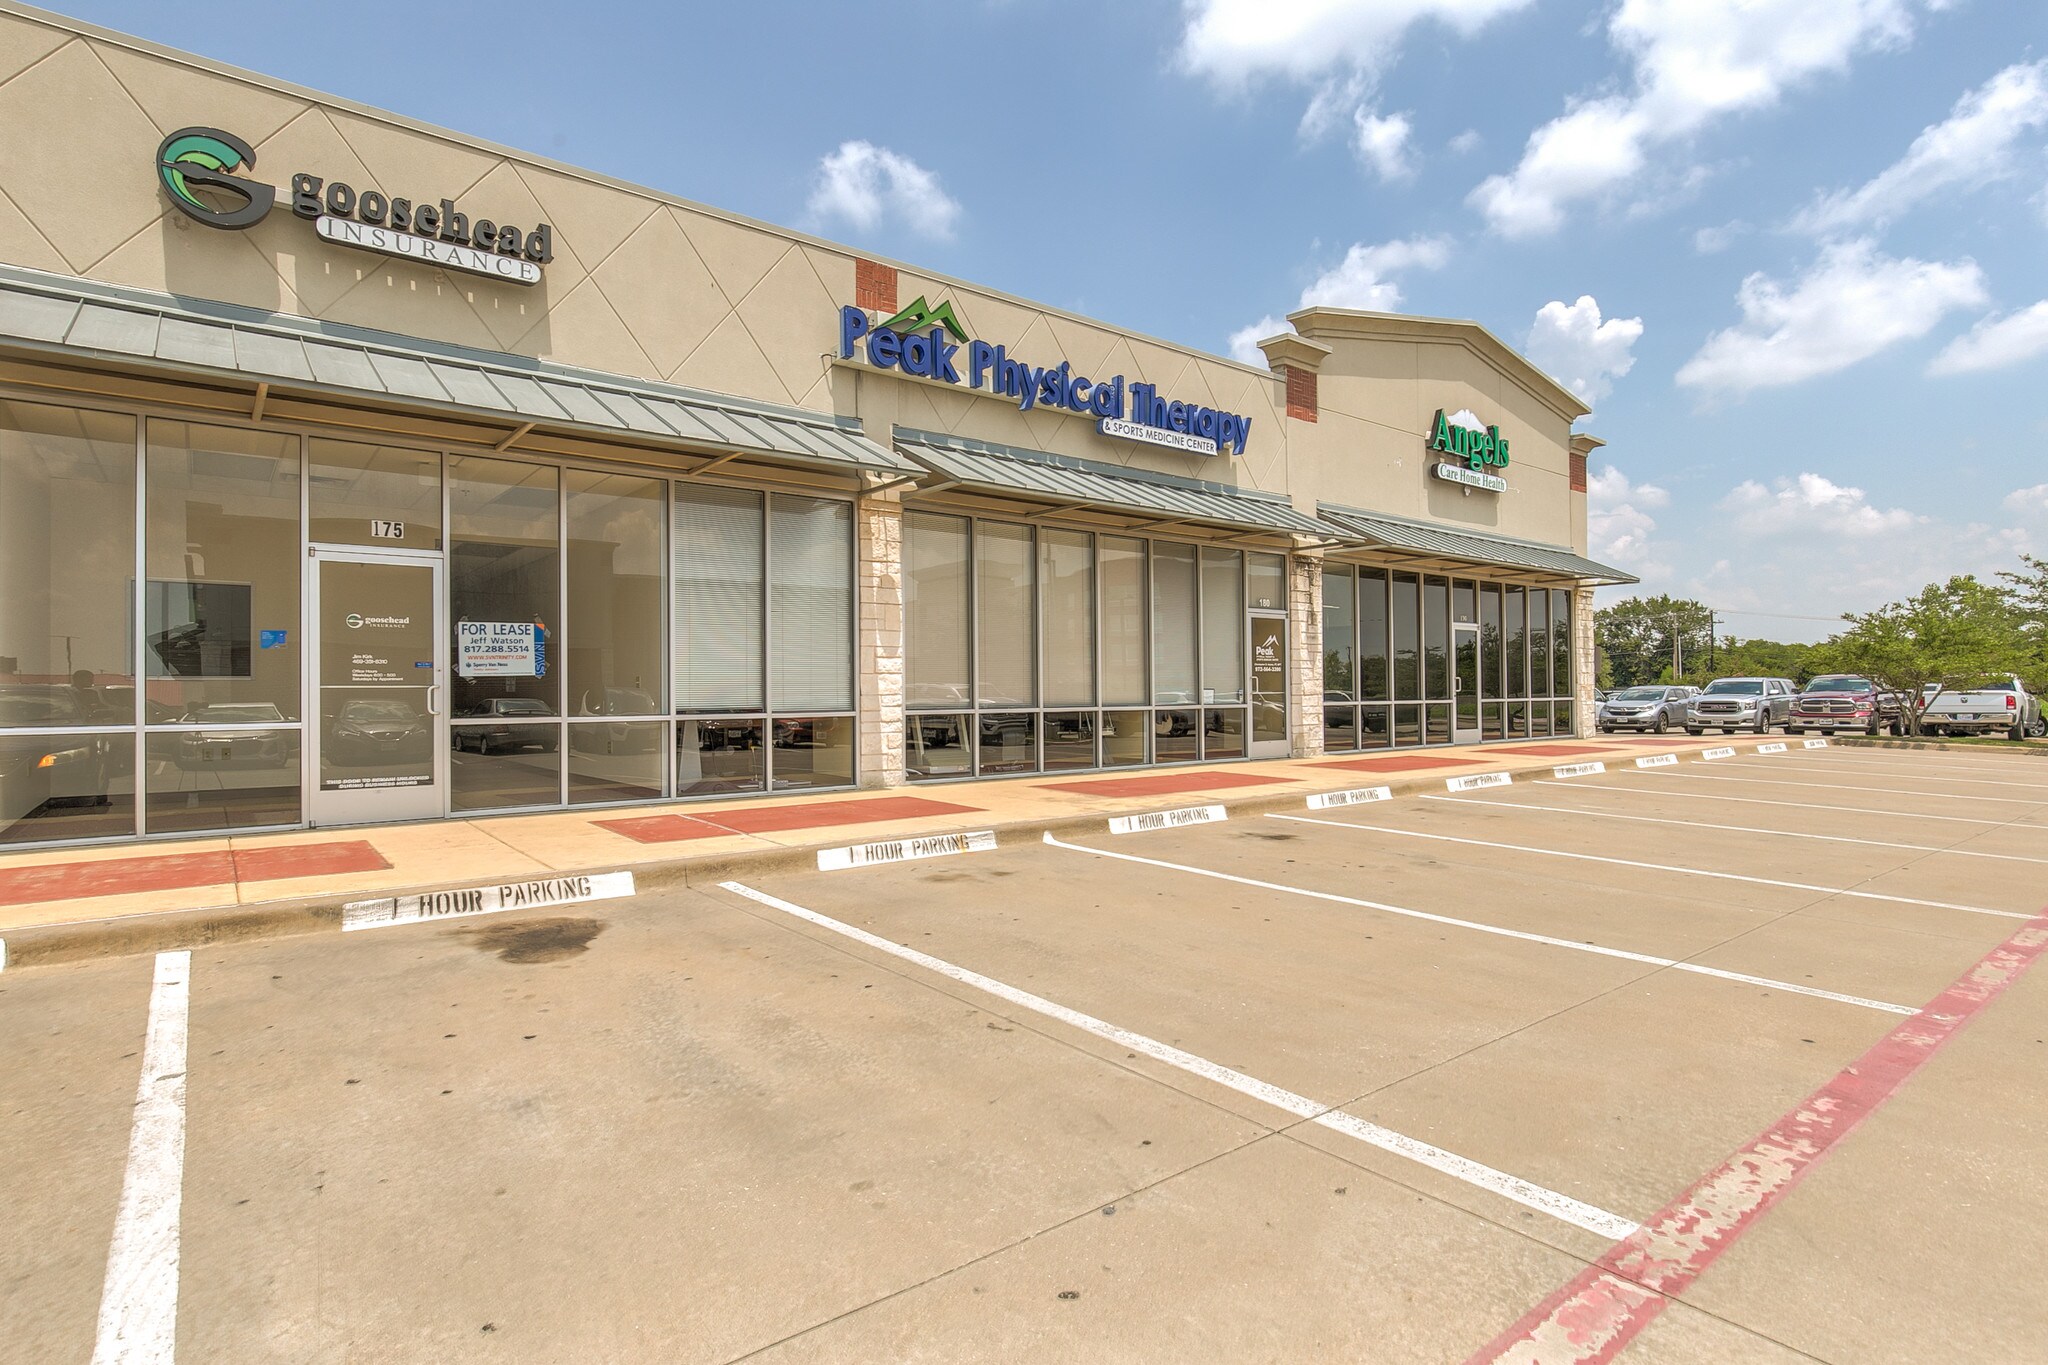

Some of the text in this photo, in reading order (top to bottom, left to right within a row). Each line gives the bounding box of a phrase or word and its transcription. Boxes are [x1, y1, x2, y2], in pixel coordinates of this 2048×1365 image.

[292, 172, 554, 264] goosehead
[325, 217, 534, 281] INSURANCE
[840, 305, 1252, 455] Peak Physical Therapy
[1104, 421, 1215, 453] & SPORTS MEDICINE CENTER
[1430, 408, 1509, 470] Angels
[1440, 464, 1505, 491] Care Home Health
[373, 521, 403, 538] 175
[365, 616, 409, 624] goosehead
[461, 623, 531, 636] FOR LEASE
[464, 645, 530, 653] 817.288.5514
[470, 636, 524, 645] Jeff Watson
[1255, 646, 1274, 656] Peak
[1328, 792, 1348, 806] HOUR
[1350, 789, 1380, 803] PARKING
[1127, 807, 1210, 831] 1 HOUR PARKING
[849, 834, 970, 863] 1 HOUR PARKING
[390, 876, 592, 920] 1 HOUR PARKING
